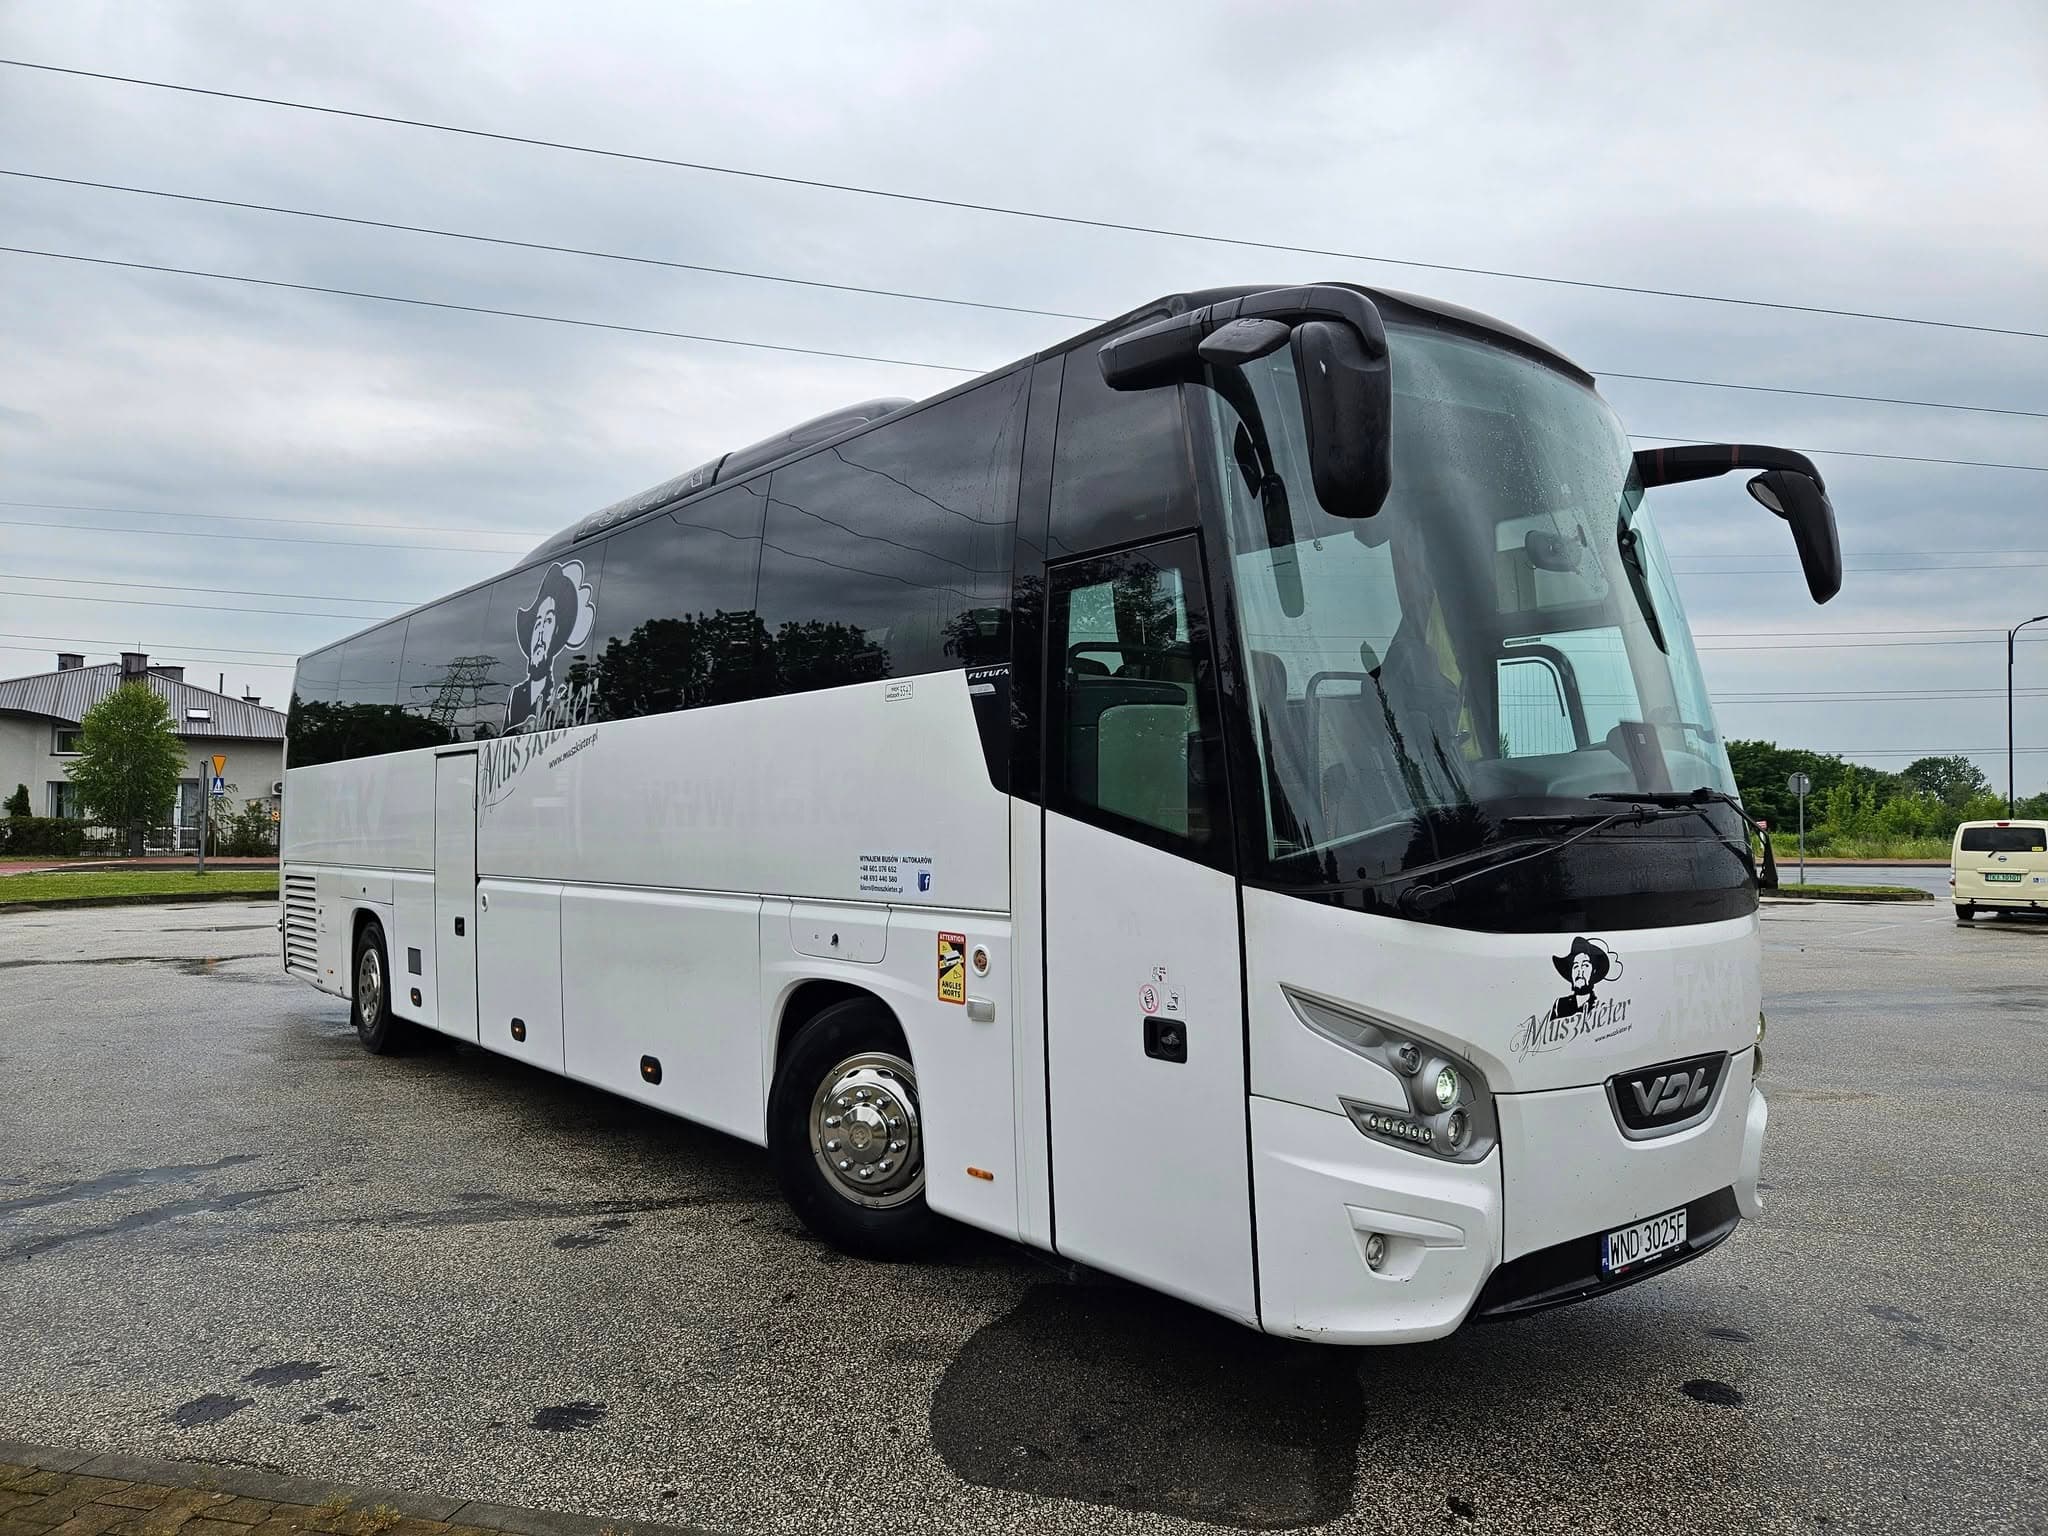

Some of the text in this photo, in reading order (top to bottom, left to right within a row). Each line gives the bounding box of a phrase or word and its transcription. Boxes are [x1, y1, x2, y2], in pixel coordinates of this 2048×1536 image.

[968, 668, 1009, 680] FUTURA
[860, 855, 881, 863] WYNAJEM
[882, 855, 899, 864] BUSÓW
[902, 856, 932, 865] AUTOKARÓW
[940, 933, 965, 942] ATTENTION
[942, 981, 962, 990] ANGLES
[943, 989, 961, 998] MORTS
[1631, 1067, 1709, 1117] VDL
[1610, 1211, 1686, 1266] WND 3025F
